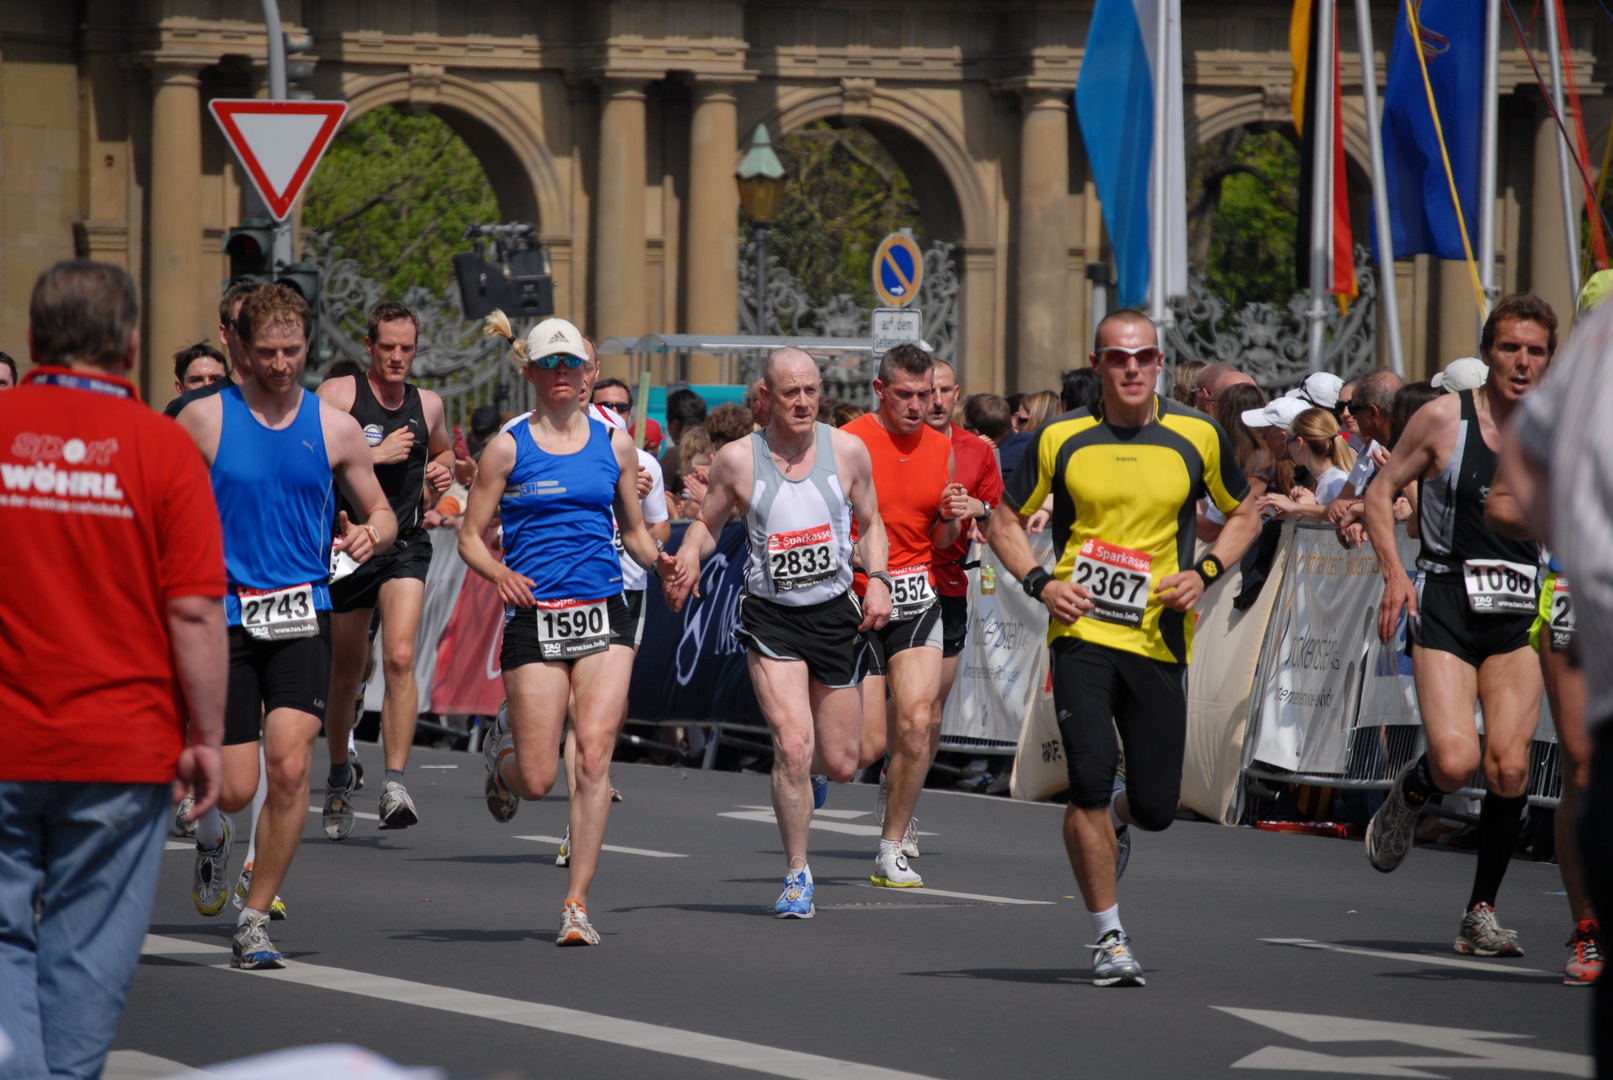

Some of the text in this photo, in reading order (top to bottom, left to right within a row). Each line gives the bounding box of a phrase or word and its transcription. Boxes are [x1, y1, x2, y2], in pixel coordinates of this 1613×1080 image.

[0, 460, 124, 500] WÖHRL
[783, 530, 831, 547] Sparkasse
[772, 546, 830, 577] 2833
[1096, 546, 1150, 569] Sparkasse
[889, 575, 930, 603] 552
[1077, 561, 1146, 603] 2367
[245, 591, 309, 625] 2743
[543, 606, 603, 638] 1590
[1094, 606, 1139, 622] www.tao.info
[273, 624, 315, 634] www.tao.info
[566, 639, 605, 652] www.tao.info
